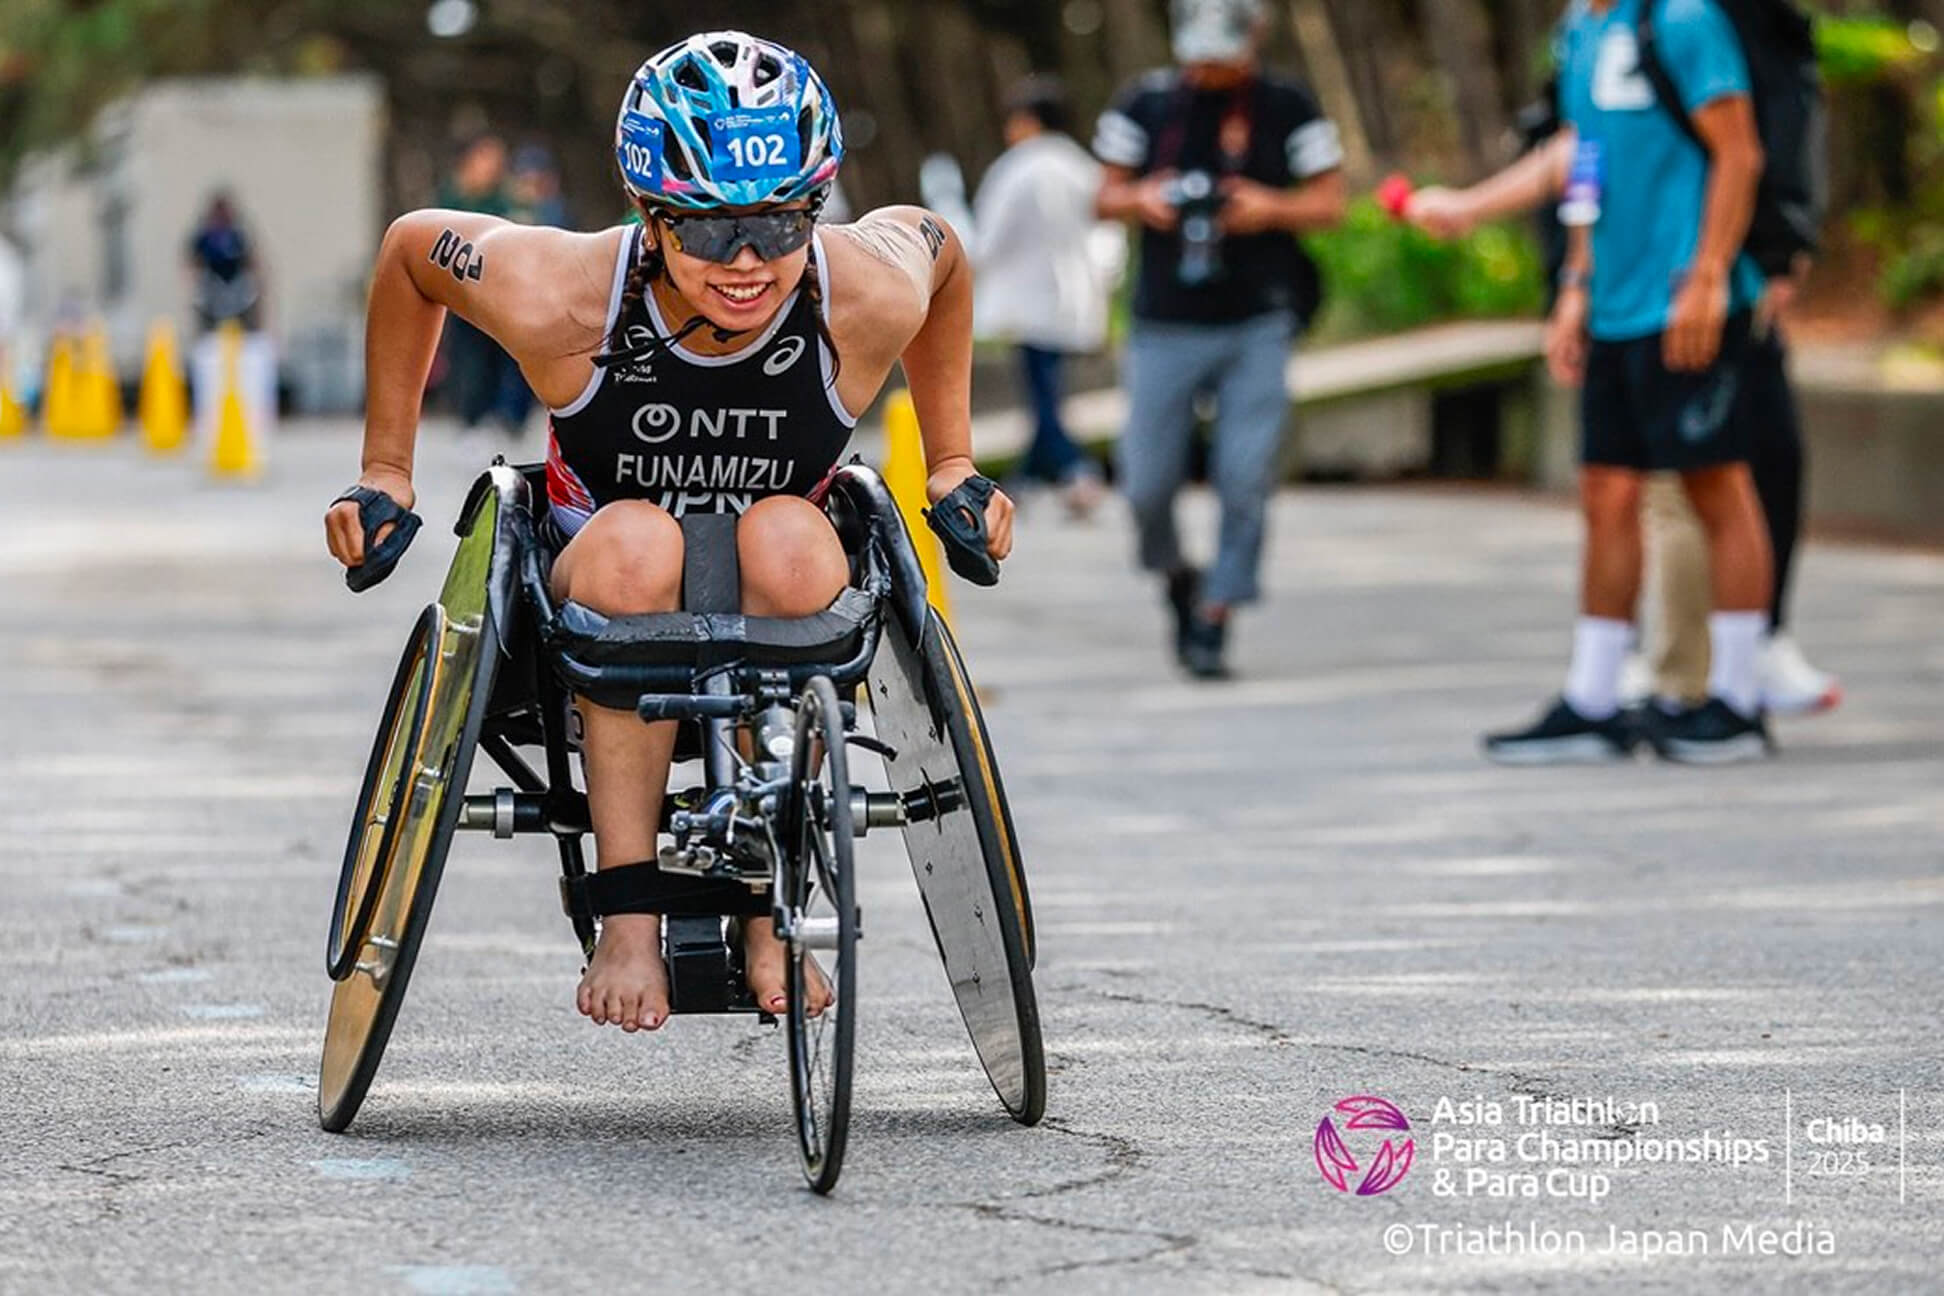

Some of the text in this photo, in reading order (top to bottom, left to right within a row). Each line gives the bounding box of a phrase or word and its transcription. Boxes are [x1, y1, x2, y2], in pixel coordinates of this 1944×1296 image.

[624, 141, 652, 178] 102
[727, 134, 787, 168] 102
[690, 408, 787, 440] NTT
[615, 453, 795, 490] FUNAMIZU
